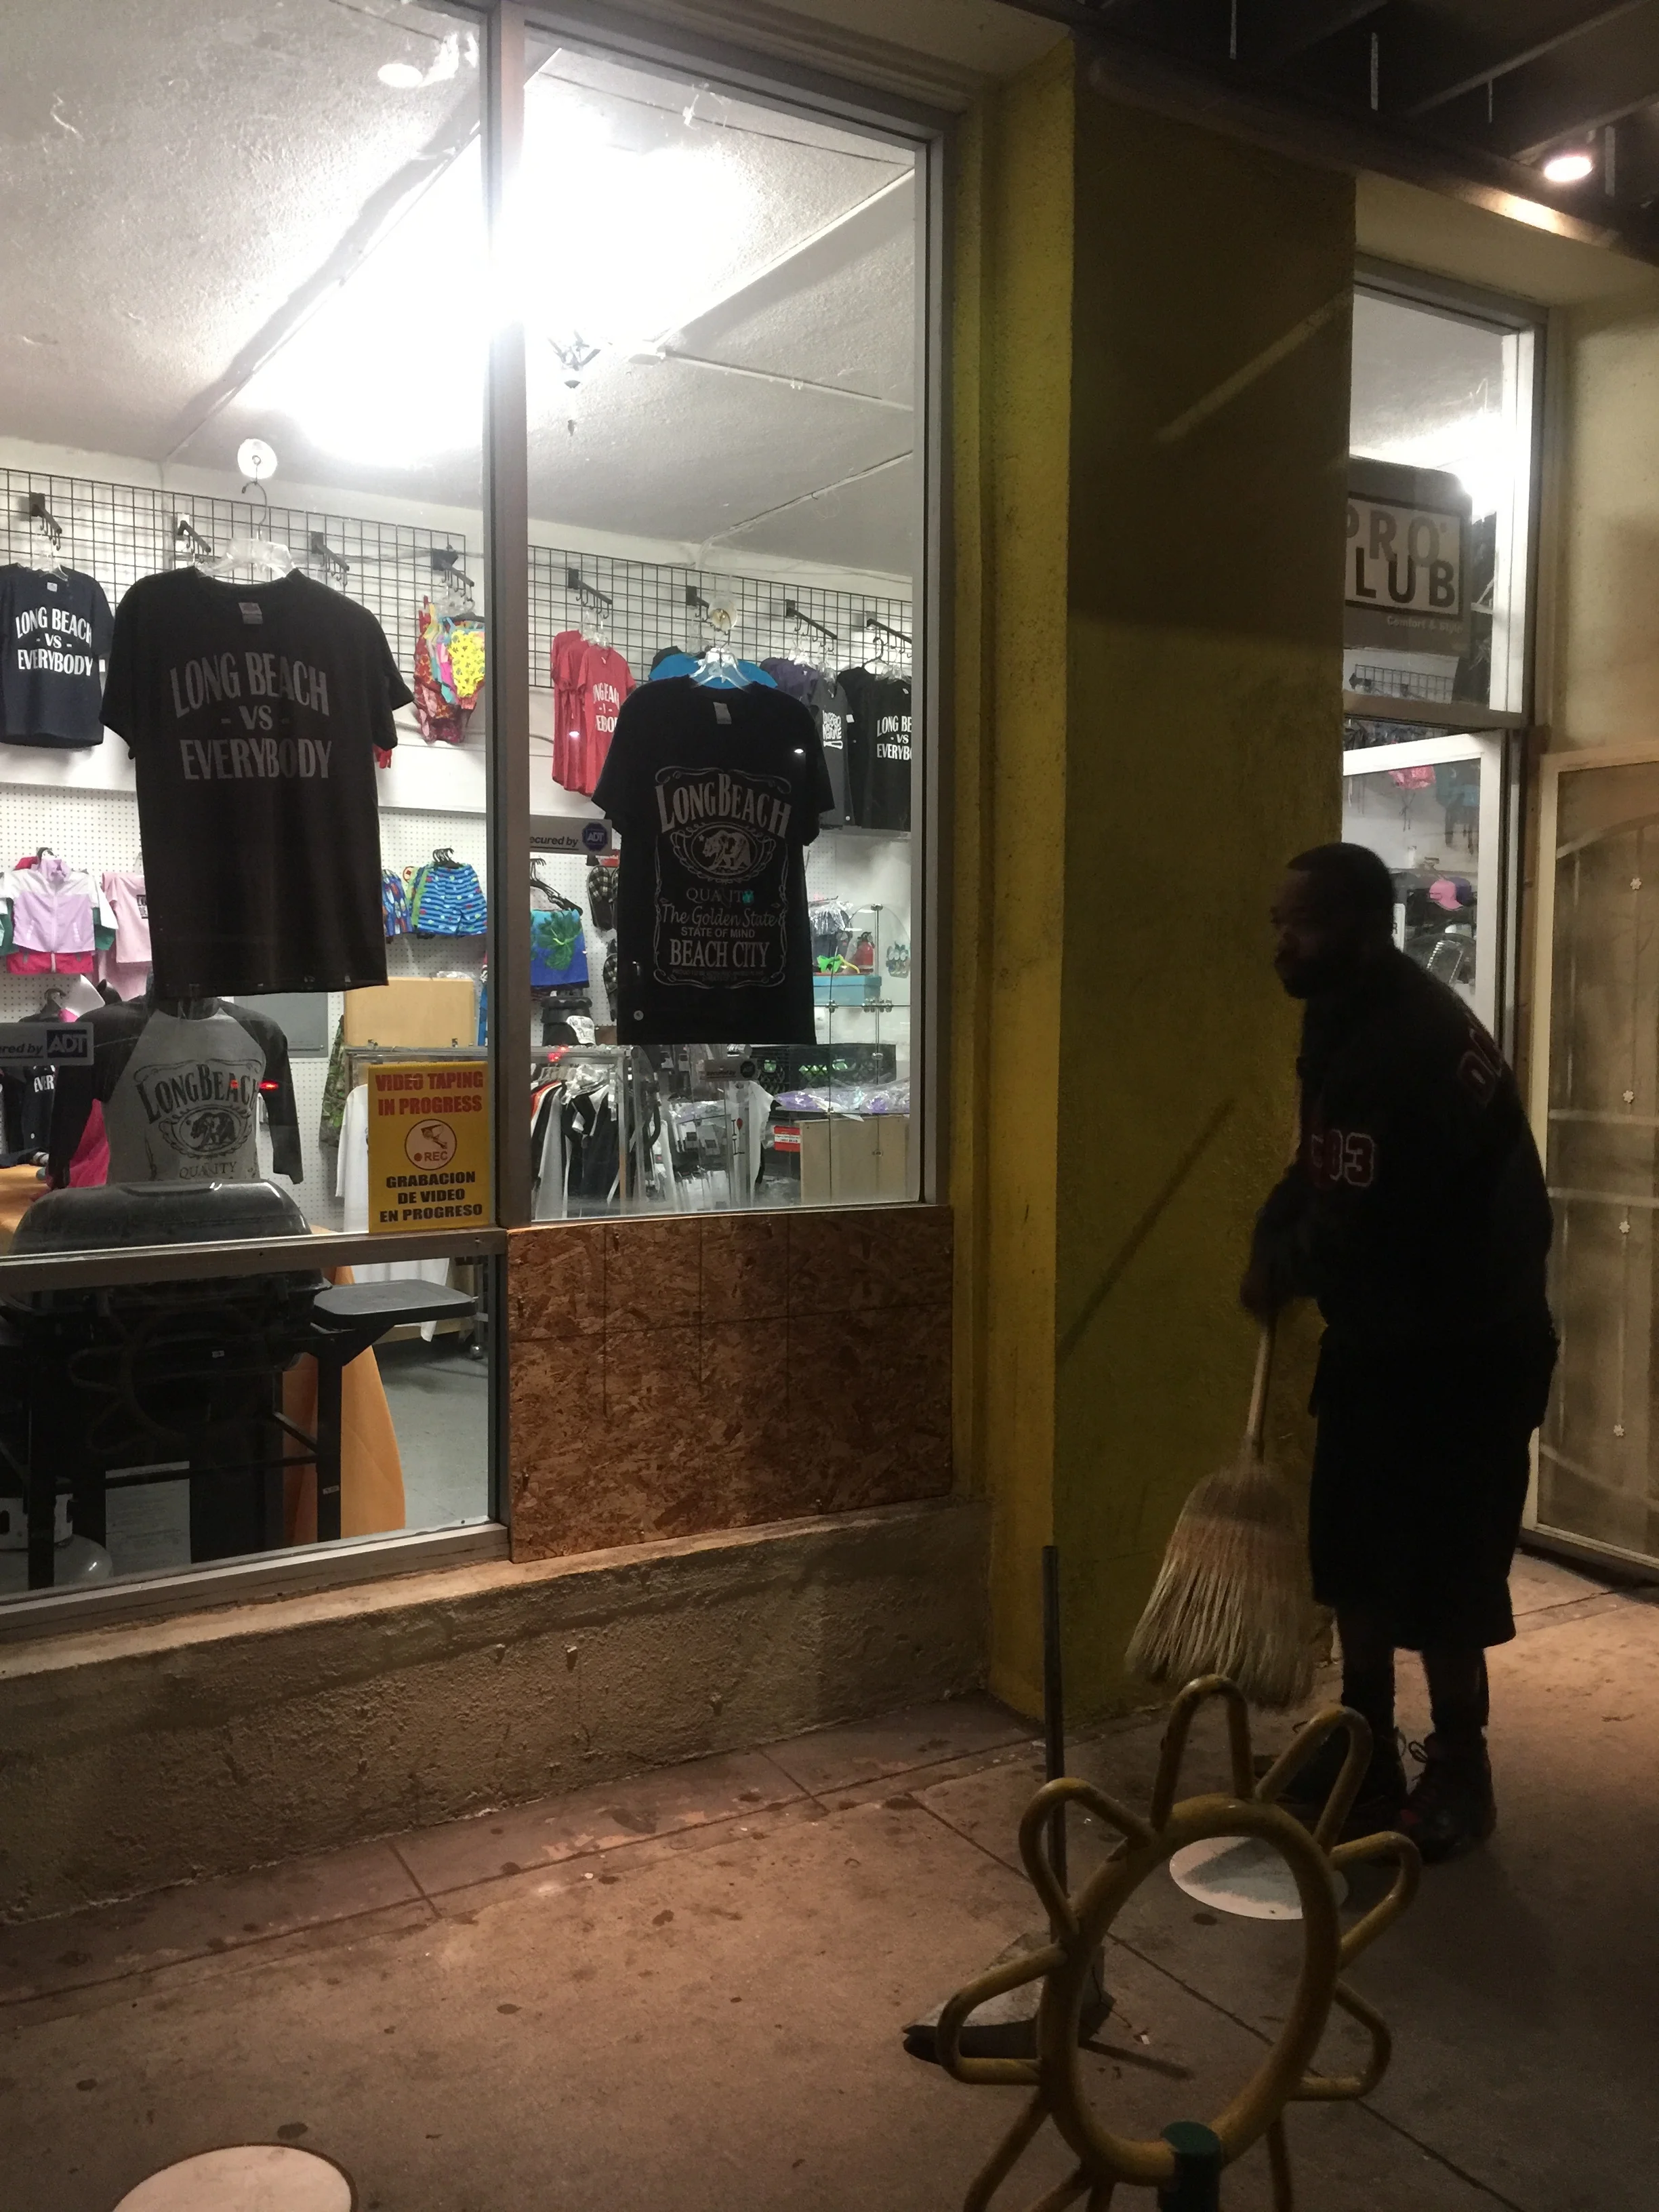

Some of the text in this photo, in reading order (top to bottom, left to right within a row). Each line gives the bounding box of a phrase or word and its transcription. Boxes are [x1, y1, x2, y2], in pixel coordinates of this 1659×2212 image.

[16, 607, 92, 648] LONG BEACH
[1387, 615, 1426, 630] Comfort
[18, 649, 93, 676] EVERYBODY
[169, 652, 329, 718] LONG BEACH
[877, 716, 899, 737] LONG
[180, 738, 332, 779] EVERYBODY
[877, 743, 912, 760] EVERYB
[566, 837, 579, 847] by
[586, 832, 604, 842] ADT
[661, 903, 777, 927] The Golden State
[681, 927, 755, 938] STATE OF MIND
[670, 939, 770, 968] BEACH CITY
[27, 1044, 43, 1055] by
[47, 1033, 87, 1053] ADT
[375, 1071, 483, 1092] VIDEO TAPING
[378, 1095, 483, 1115] IN PROGRESS
[424, 1151, 448, 1162] REC
[386, 1171, 476, 1188] GRABACION
[398, 1188, 465, 1204] DE VIDEO
[380, 1204, 483, 1223] EN PROGRESO
